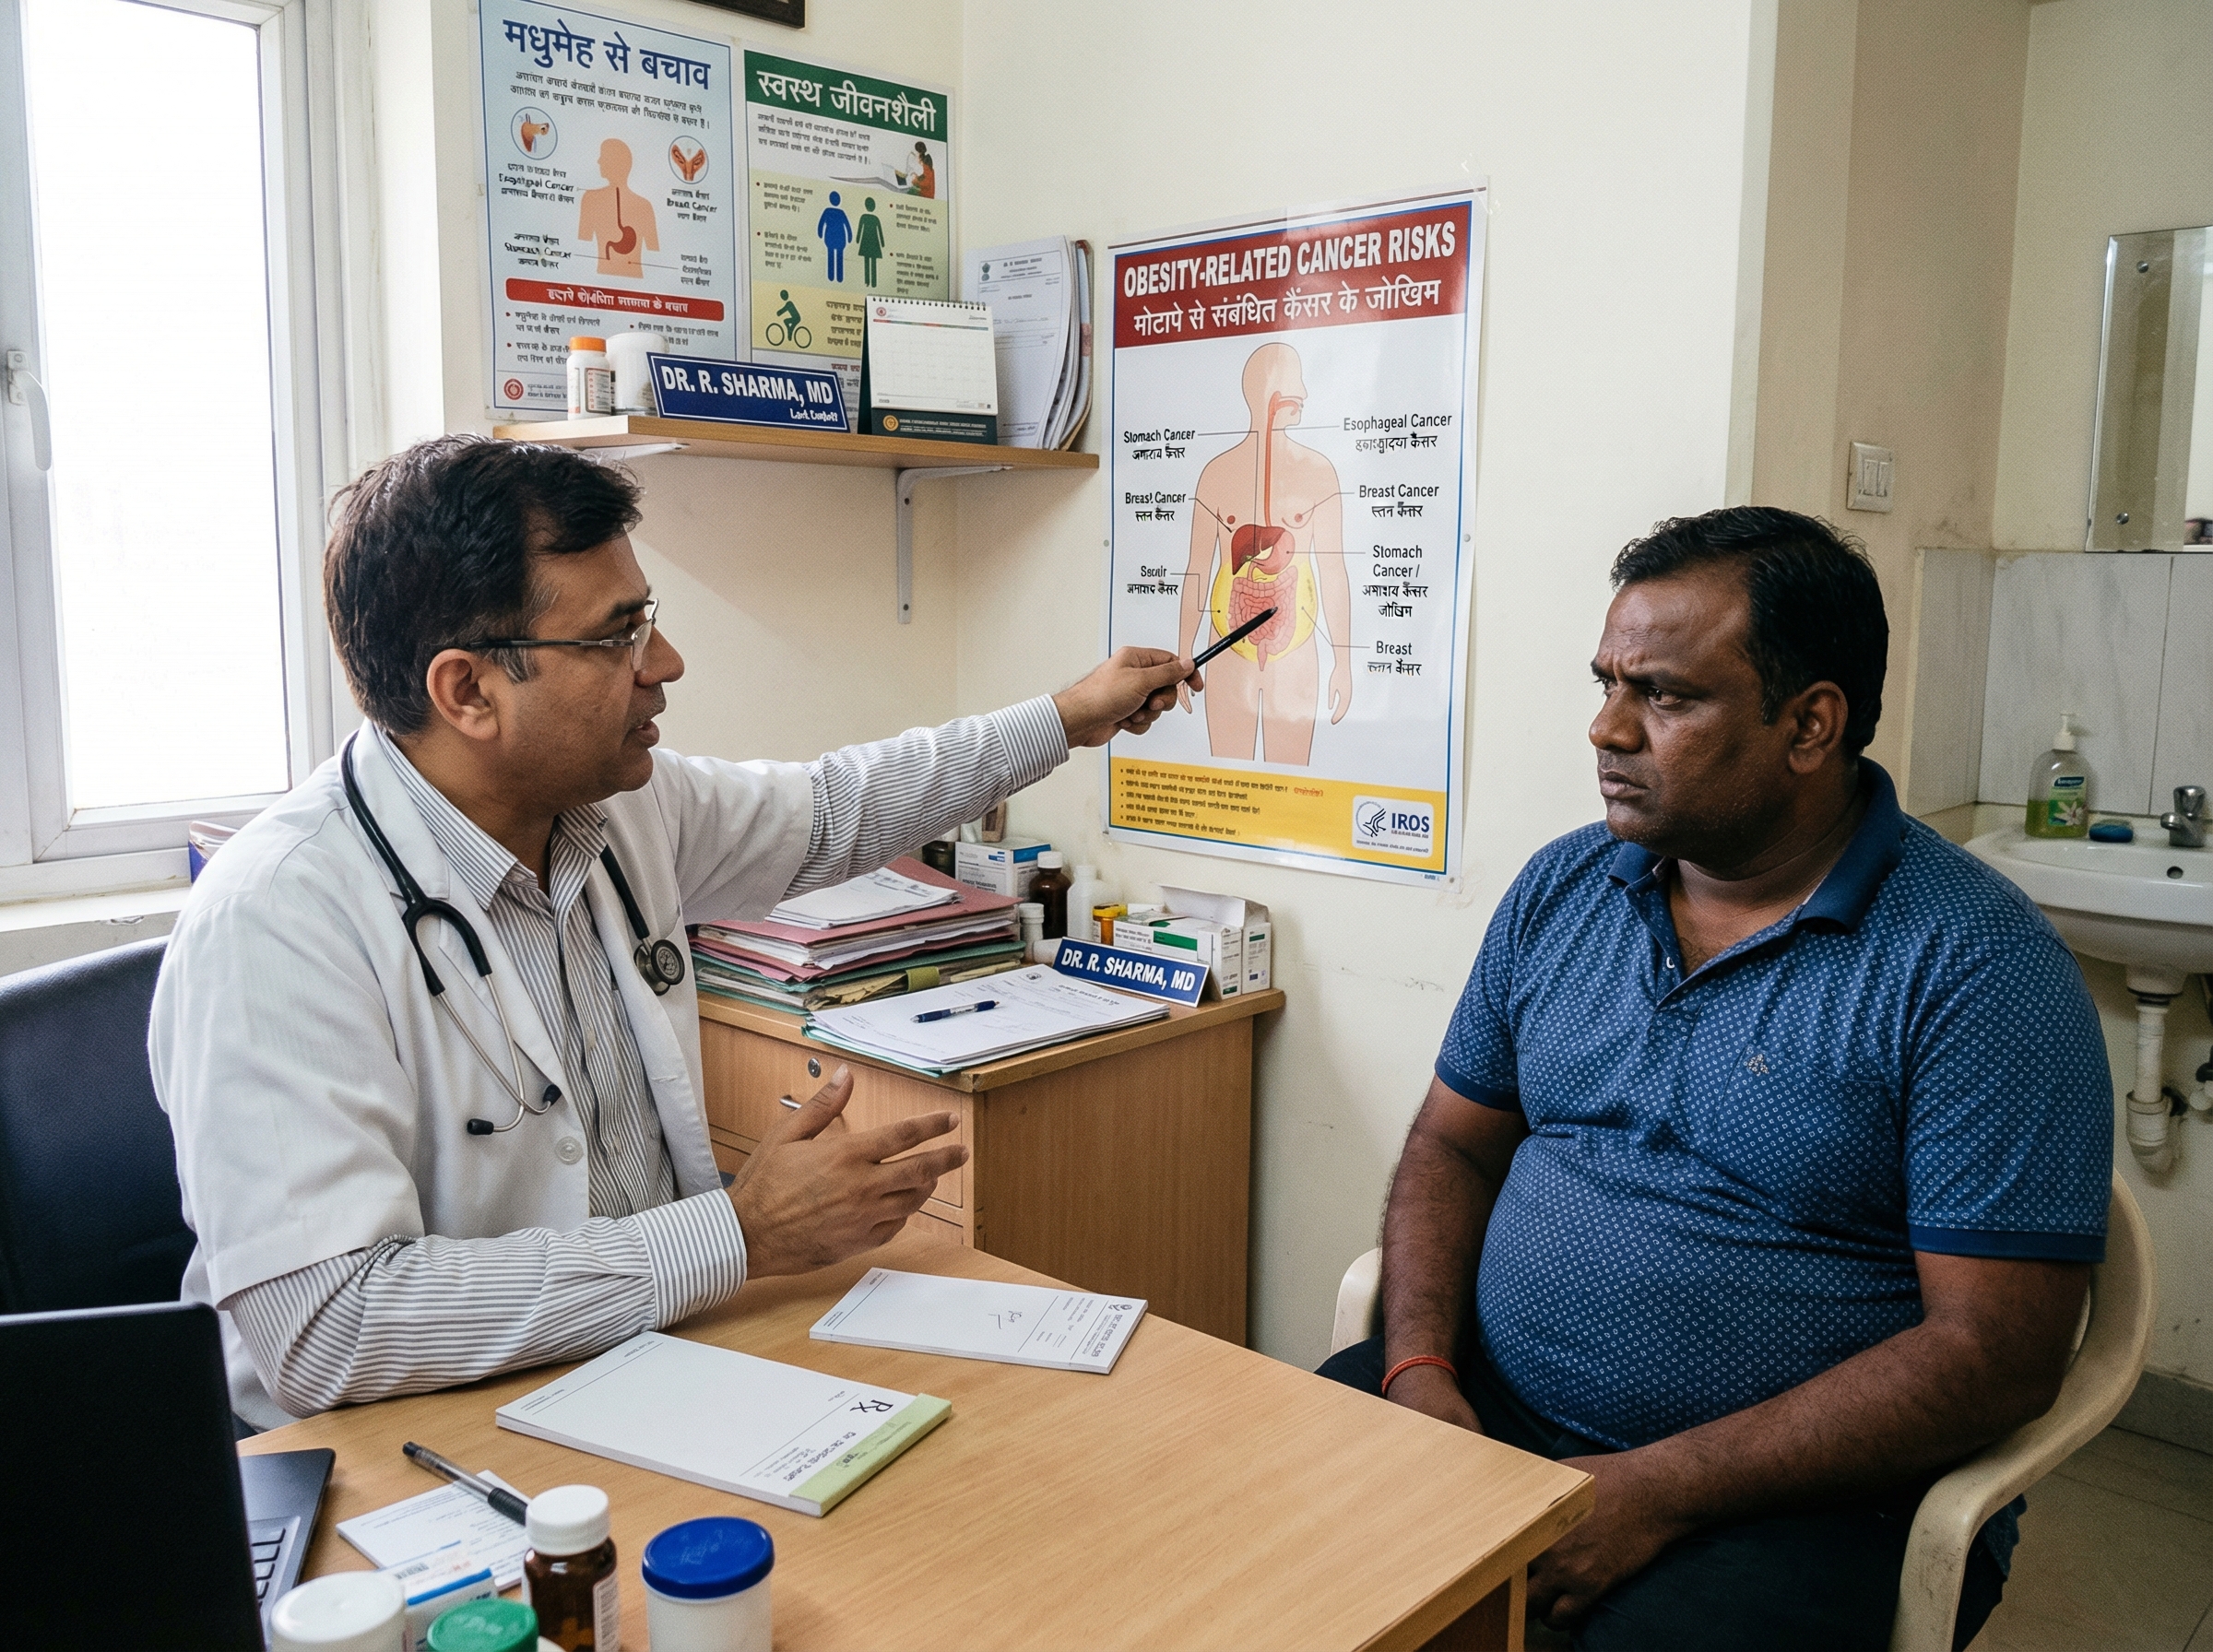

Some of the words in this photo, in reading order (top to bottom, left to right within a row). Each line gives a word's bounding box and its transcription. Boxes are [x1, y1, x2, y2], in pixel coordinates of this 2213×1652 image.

[503, 18, 595, 68] मधुमेह
[603, 30, 631, 74] से
[640, 48, 711, 90] बचाव
[756, 70, 822, 108] स्वस्थ
[829, 79, 937, 133] जीवनशैली
[1123, 244, 1291, 298] OBESITY-RELATED
[1296, 231, 1381, 275] CANCER
[1388, 220, 1456, 265] RISKS
[1133, 302, 1183, 337] मोटापे
[1189, 300, 1205, 331] से
[1211, 293, 1277, 327] संबंधित
[1283, 287, 1332, 321] कैंसर
[1339, 281, 1359, 314] के
[1365, 274, 1441, 311] जोखिम
[660, 365, 695, 393] DR.
[698, 370, 718, 394] R.
[721, 372, 805, 407] SHARMA,
[805, 380, 834, 405] MD
[1343, 414, 1407, 433] Esophageal
[1411, 413, 1452, 428] Cancer
[1164, 428, 1196, 442] Cancer
[1359, 484, 1395, 498] Breast
[1398, 484, 1440, 498] Cancer
[1373, 563, 1414, 578] Cancer
[1415, 564, 1420, 578] /
[1376, 641, 1413, 655] Breast
[1391, 812, 1430, 833] IROS
[1061, 948, 1083, 969] DR.
[1086, 952, 1100, 972] R.
[1104, 956, 1167, 990] SHARMA,
[1170, 969, 1196, 991] MD
[849, 1399, 893, 1412] Rx
